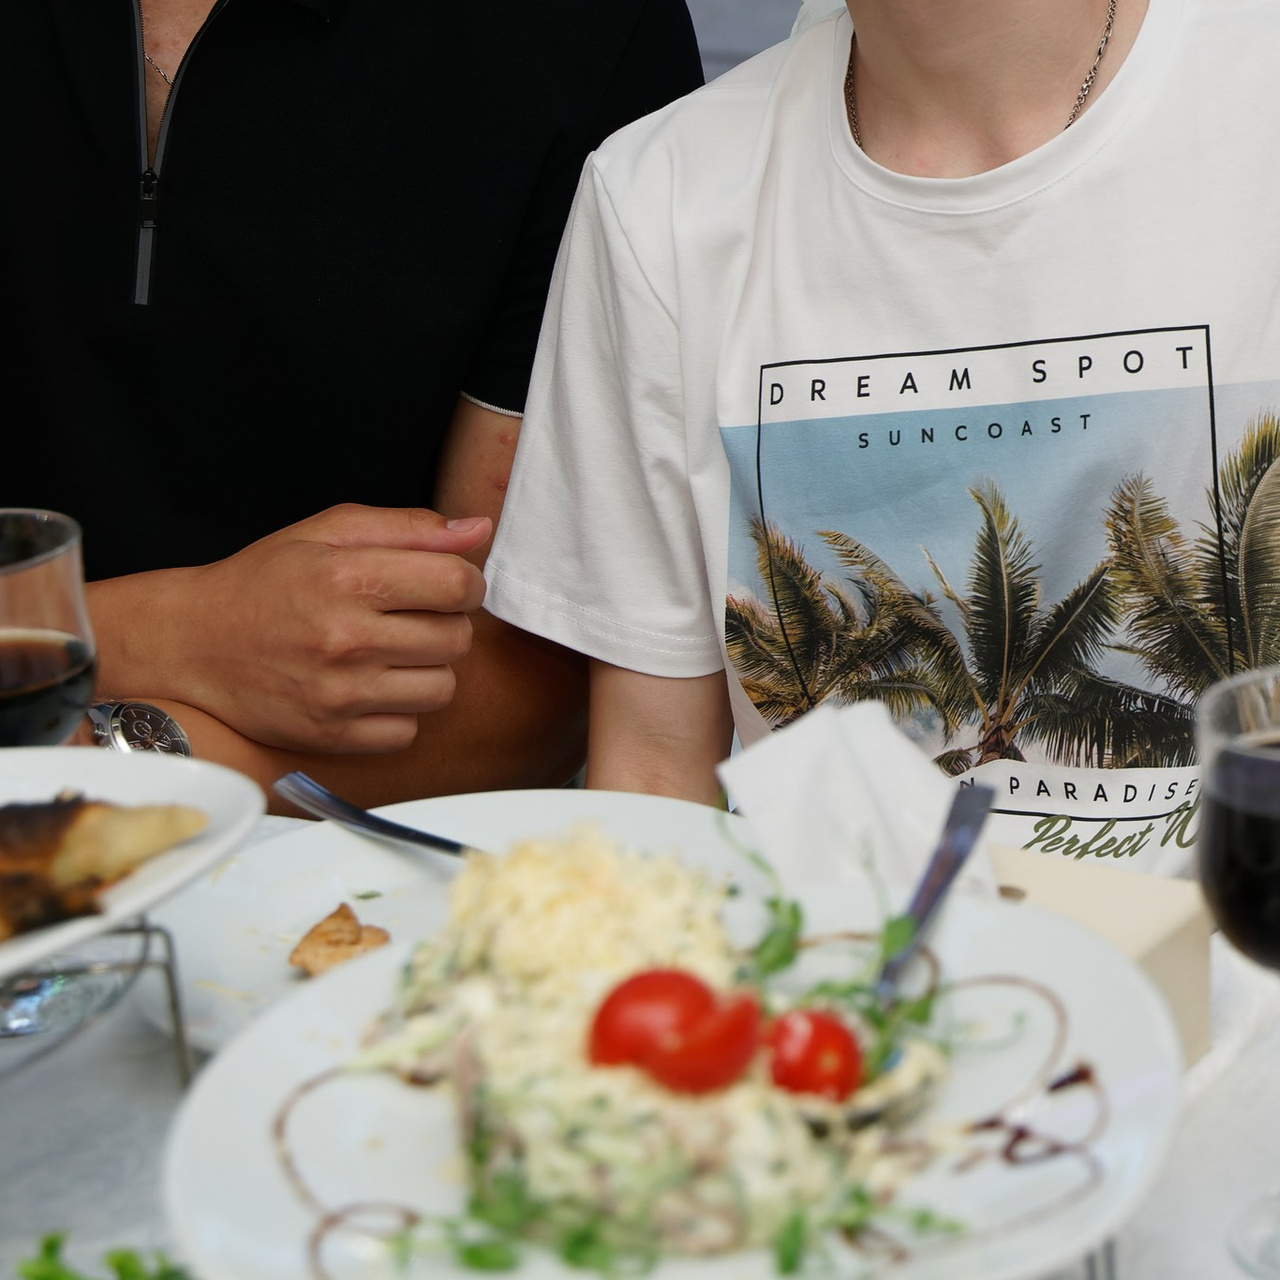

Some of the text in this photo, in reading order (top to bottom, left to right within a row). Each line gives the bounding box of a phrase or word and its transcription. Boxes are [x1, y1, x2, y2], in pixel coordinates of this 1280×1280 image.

[770, 346, 1193, 405] DREAM SPOT
[858, 414, 1091, 449] SUNCOAST
[1009, 776, 1199, 803] PARADISE
[1020, 814, 1155, 861] Perfect
